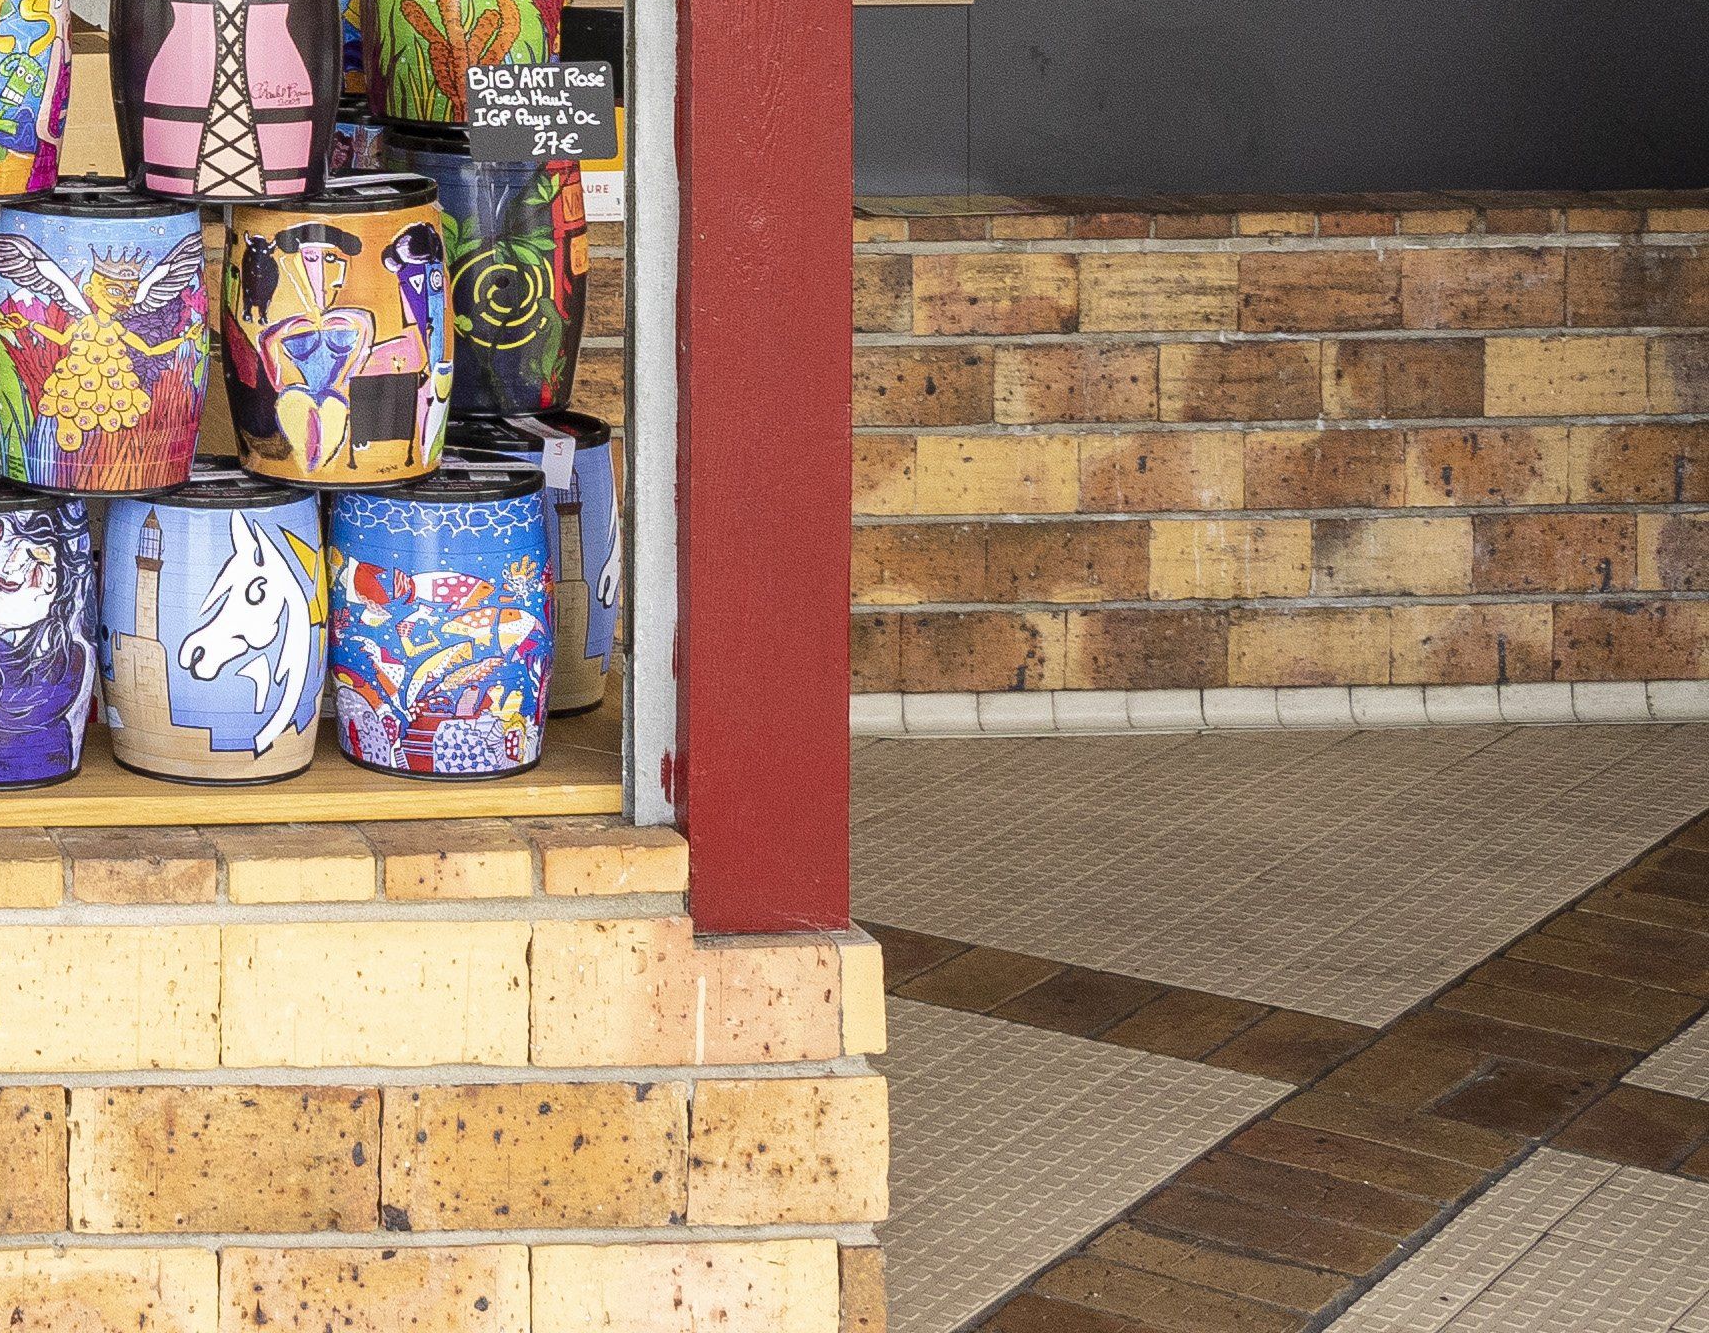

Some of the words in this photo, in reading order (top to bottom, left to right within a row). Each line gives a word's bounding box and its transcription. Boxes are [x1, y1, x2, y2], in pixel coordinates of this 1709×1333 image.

[564, 65, 608, 88] Rosé
[478, 89, 530, 107] Puech
[530, 89, 573, 107] Haut
[472, 109, 510, 128] IGP
[514, 109, 552, 132] Pays
[531, 132, 583, 156] 27€
